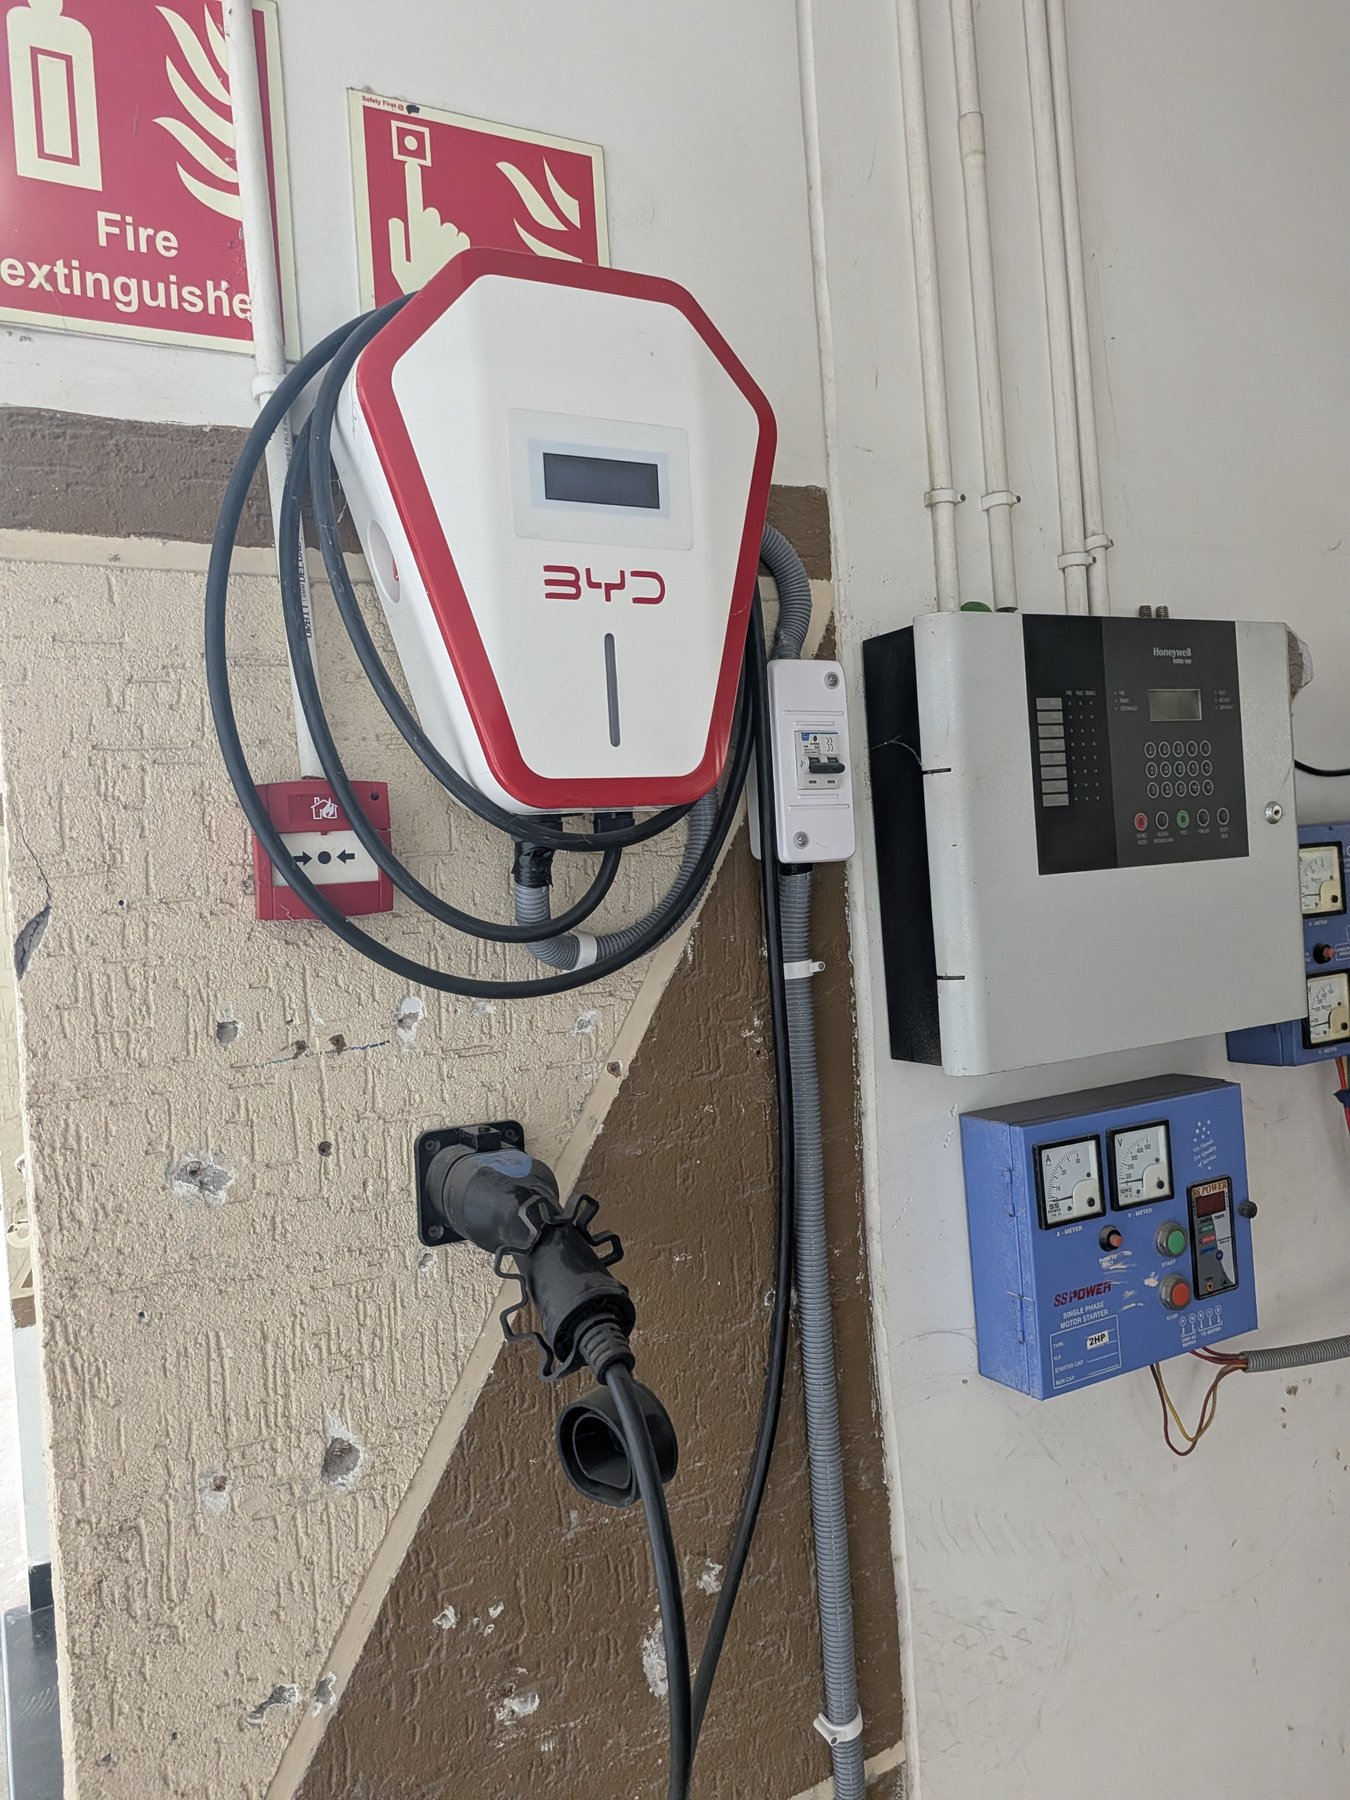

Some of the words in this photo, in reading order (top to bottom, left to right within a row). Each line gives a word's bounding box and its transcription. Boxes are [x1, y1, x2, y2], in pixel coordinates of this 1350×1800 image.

[362, 96, 382, 106] Safety
[382, 99, 397, 109] First
[97, 210, 179, 258] Fire
[0, 256, 252, 320] extinguishe
[543, 564, 666, 604] BYD
[1152, 647, 1192, 659] Honeywell
[1046, 1154, 1051, 1163] A
[1202, 1181, 1227, 1194] POWER
[1049, 1202, 1060, 1210] SS
[1136, 1208, 1152, 1216] METER
[1064, 1225, 1082, 1235] METER
[1161, 1259, 1176, 1268] START
[1062, 1306, 1084, 1319] SINGLE
[1085, 1301, 1104, 1312] PHASE
[1060, 1318, 1082, 1328] MOTOR
[1082, 1309, 1109, 1322] STARTER
[1166, 1313, 1178, 1321] STOP
[1053, 1341, 1064, 1349] TYPE
[1088, 1334, 1106, 1346] 2HP
[1054, 1362, 1074, 1373] STARTER
